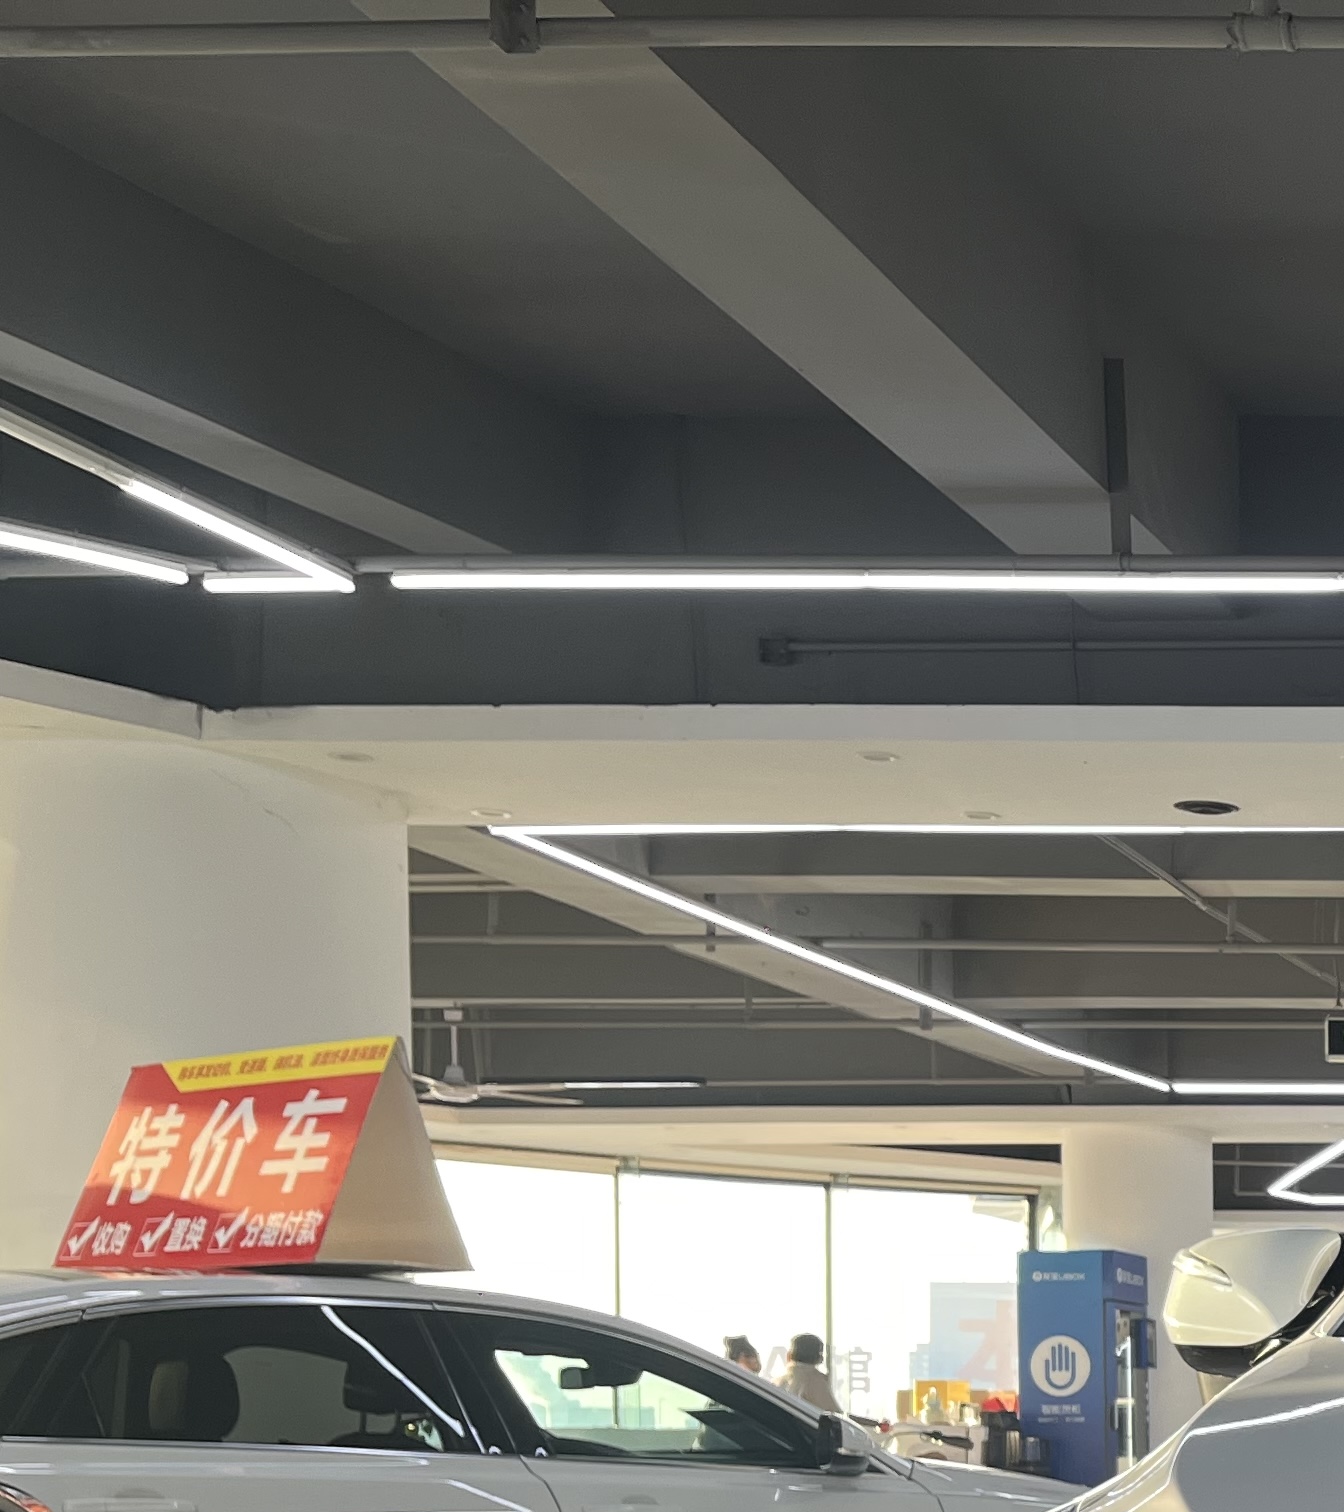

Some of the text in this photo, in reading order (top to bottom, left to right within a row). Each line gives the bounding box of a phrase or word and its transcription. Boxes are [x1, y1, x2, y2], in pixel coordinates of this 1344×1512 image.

[106, 1088, 348, 1206] 特价车
[92, 1209, 324, 1256] 收购 置换 分期付款
